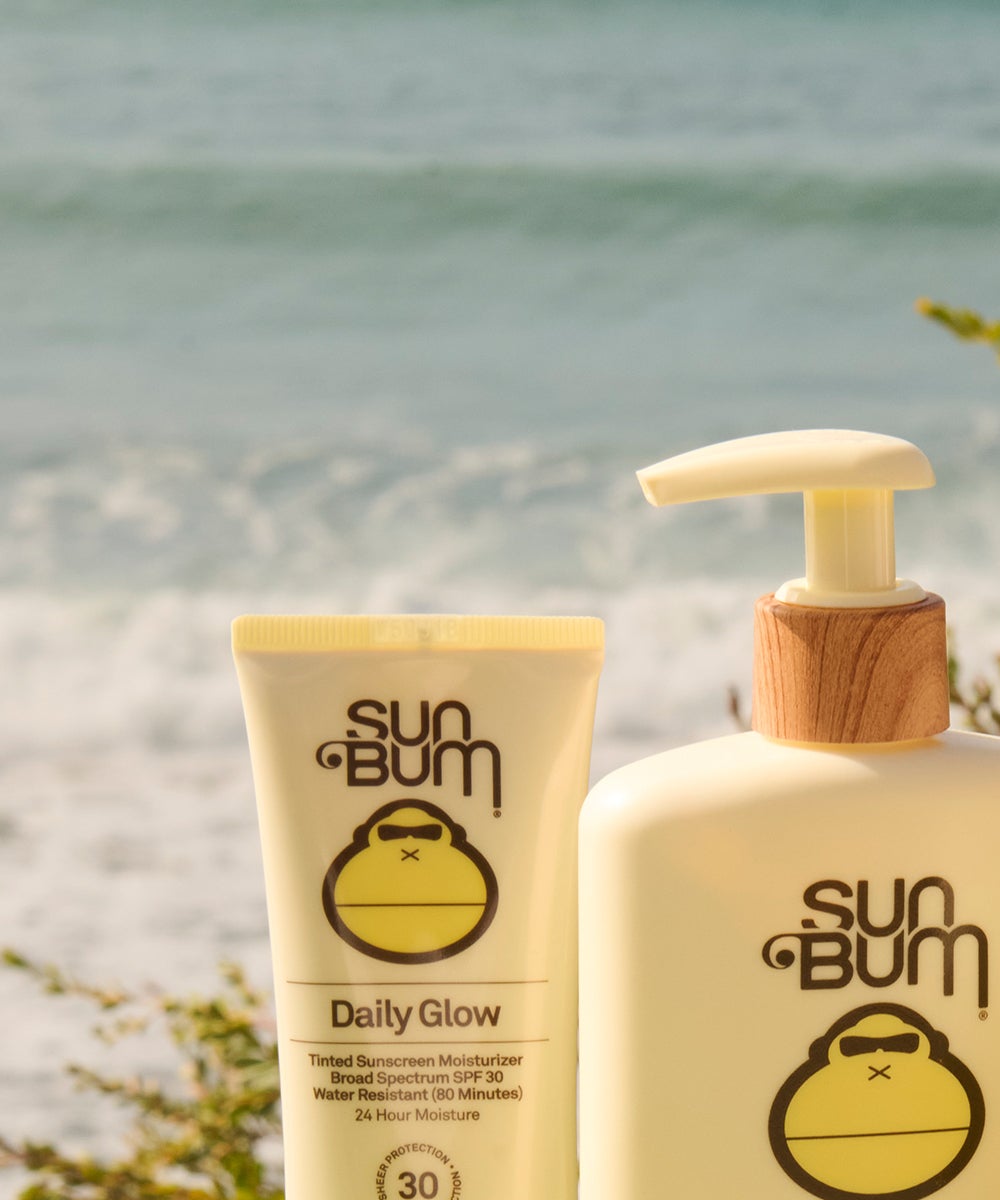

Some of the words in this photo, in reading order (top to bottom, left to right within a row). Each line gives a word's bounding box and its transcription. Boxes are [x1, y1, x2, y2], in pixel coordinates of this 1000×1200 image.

[332, 999, 413, 1035] Daily
[419, 999, 501, 1027] Glow
[309, 1054, 353, 1067] Tinted
[357, 1055, 435, 1068] Sunscreen
[439, 1054, 523, 1067] Moisturizer
[331, 1071, 373, 1084] Broad
[377, 1072, 449, 1087] Spectrum
[454, 1071, 482, 1083] SPF
[486, 1071, 503, 1083] 30
[313, 1087, 355, 1101] Water
[358, 1088, 428, 1101] Resistant
[432, 1087, 454, 1103] (80
[459, 1085, 522, 1101] Minutes)
[355, 1109, 372, 1121] 24
[377, 1109, 411, 1121] Hour
[416, 1108, 480, 1121] Moisture
[385, 1142, 450, 1165] PROTECTION
[399, 1172, 438, 1199] 30
